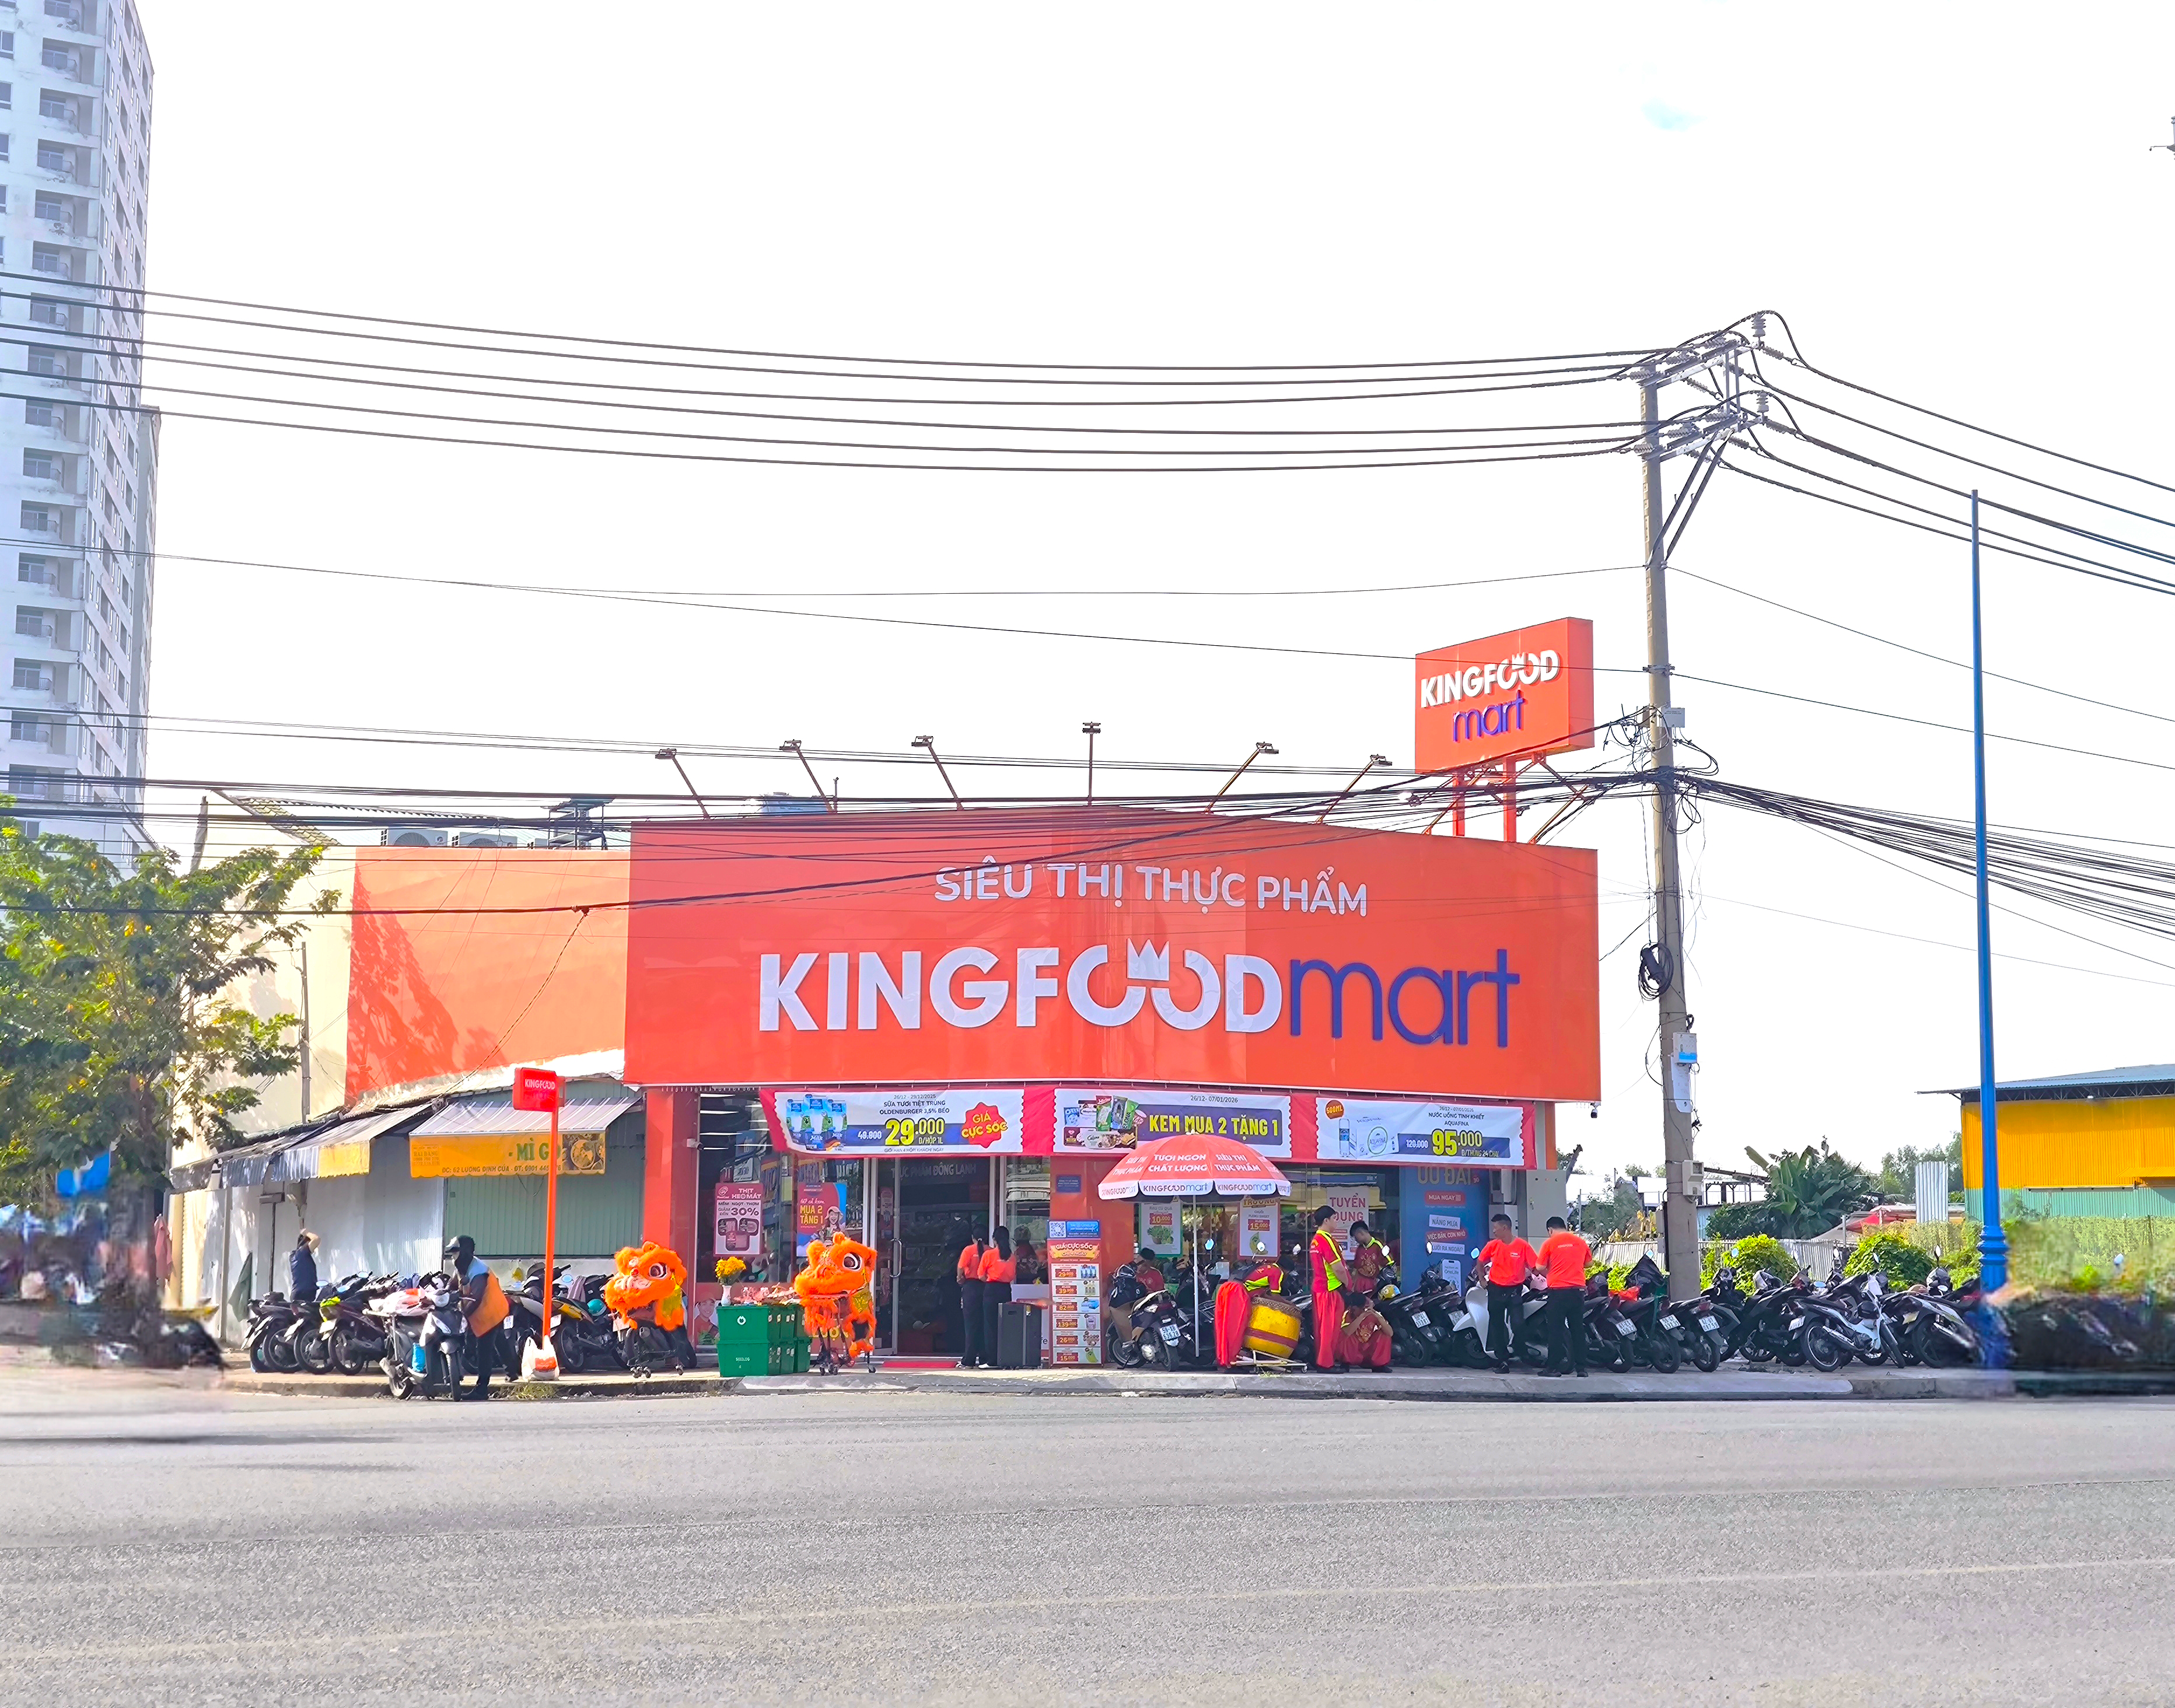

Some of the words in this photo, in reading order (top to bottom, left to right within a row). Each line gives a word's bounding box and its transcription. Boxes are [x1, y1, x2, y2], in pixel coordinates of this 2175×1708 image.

[1421, 650, 1559, 708] KINGFOOD
[1453, 690, 1526, 742] mart
[933, 855, 1032, 901] SIÊU
[1047, 863, 1123, 908] THỊ
[1135, 865, 1246, 914] THỰC
[1257, 866, 1368, 917] PHẨM
[525, 1079, 555, 1090] KINGFOOD
[1326, 1105, 1342, 1114] 500ML
[973, 1110, 991, 1124] GIÁ
[961, 1126, 984, 1139] CỰC
[985, 1120, 1008, 1133] SỐC
[1149, 1115, 1180, 1132] KEM
[1184, 1115, 1214, 1133] MUA
[1218, 1117, 1227, 1134] 2
[1231, 1114, 1268, 1140] TẶNG
[1272, 1119, 1278, 1136] 1
[1148, 1163, 1173, 1172] CHẤT
[1329, 1193, 1366, 1208] TUYỂN
[731, 1208, 759, 1216] 30%
[800, 1205, 815, 1213] MUA
[817, 1205, 823, 1213] 2
[800, 1214, 818, 1225] TẶNG
[820, 1215, 823, 1224] 1
